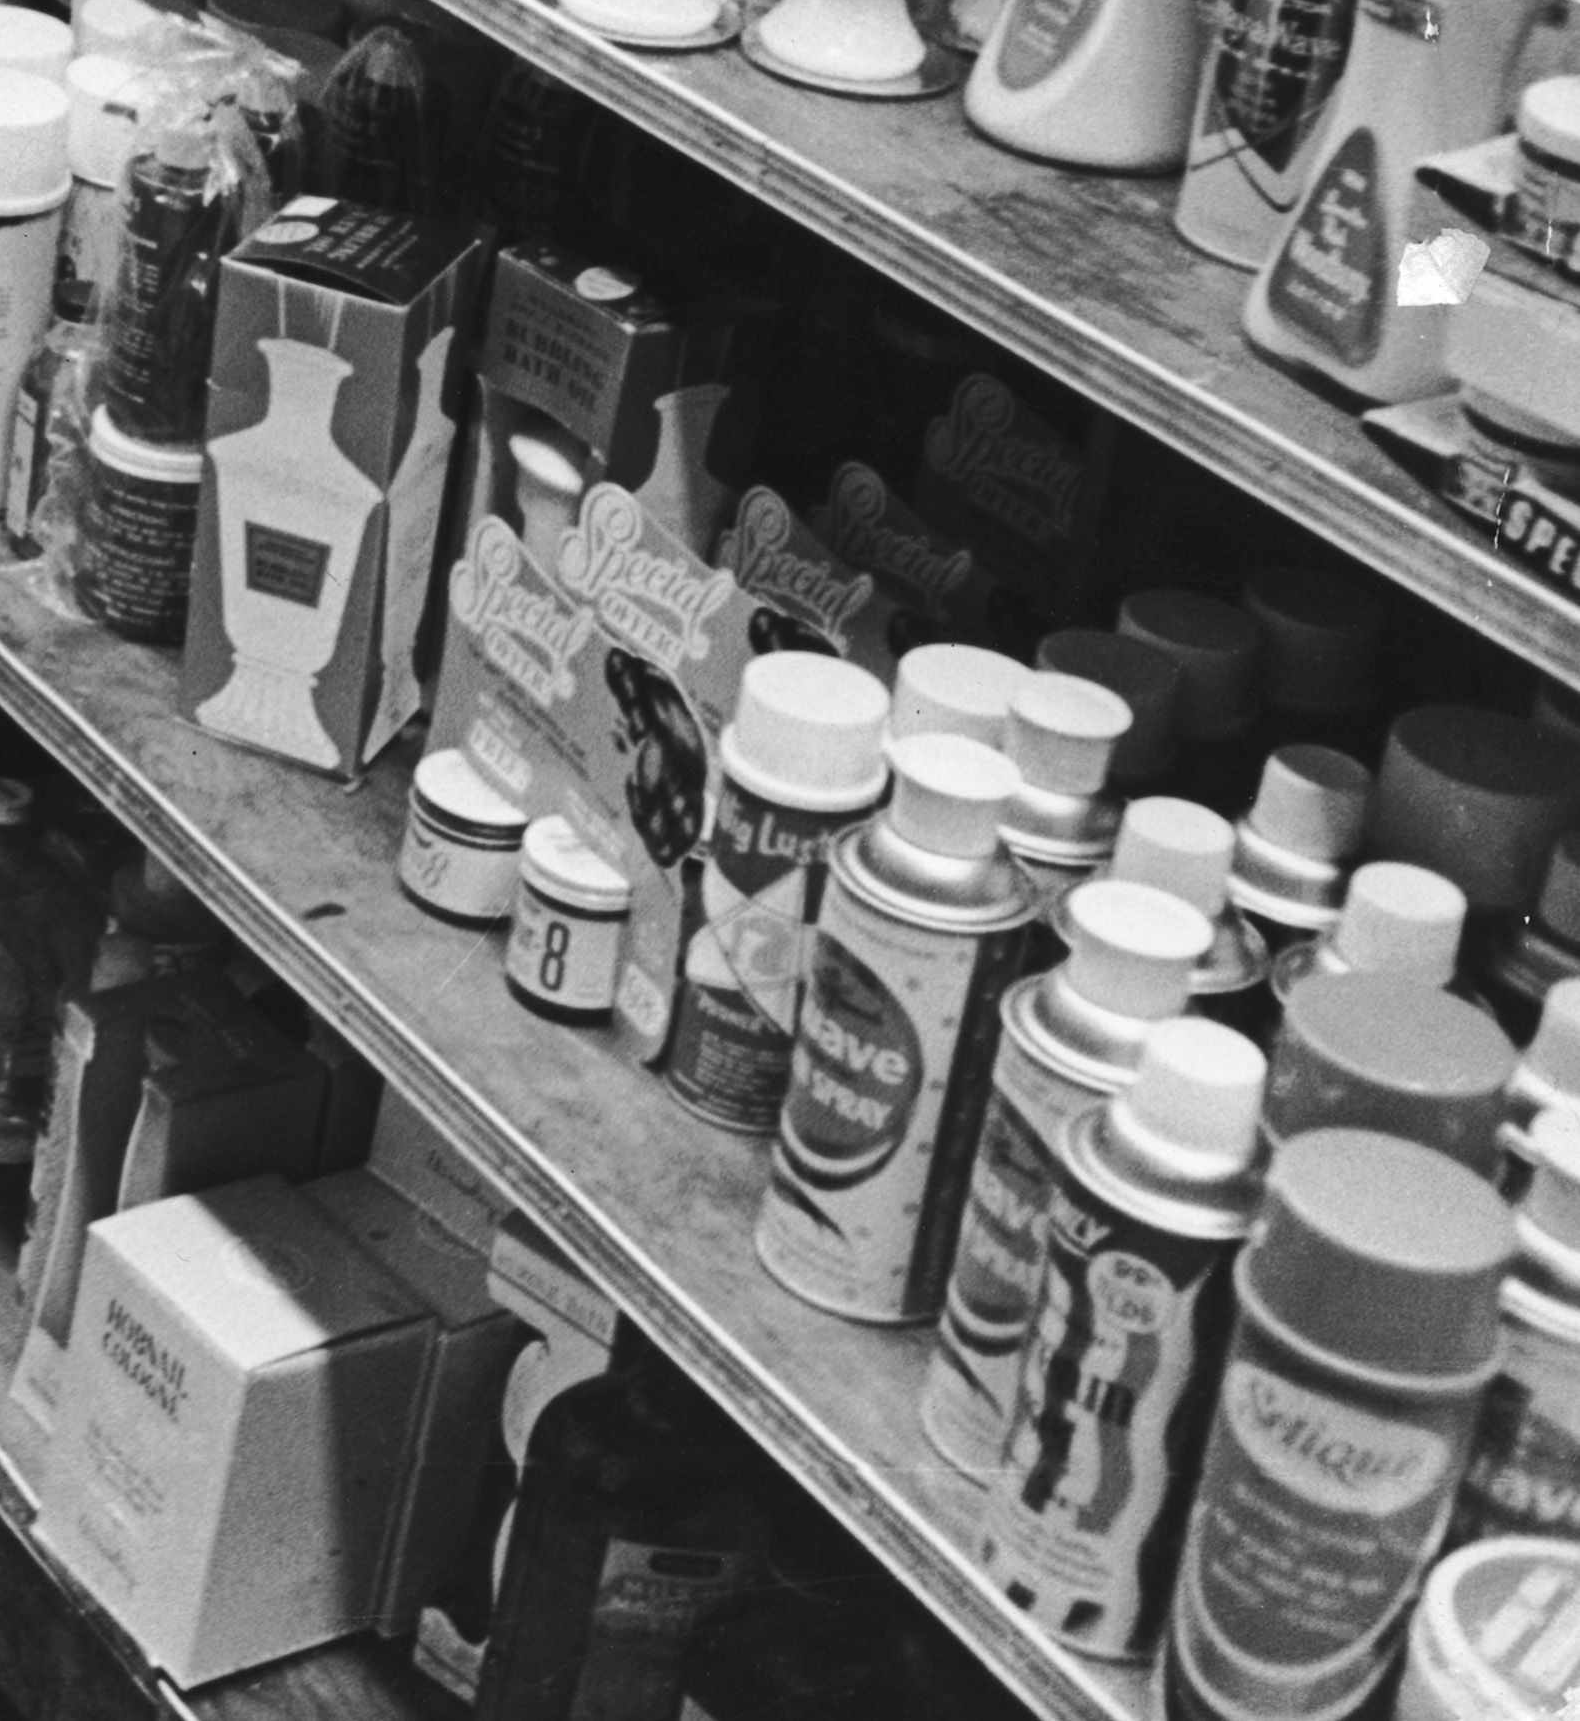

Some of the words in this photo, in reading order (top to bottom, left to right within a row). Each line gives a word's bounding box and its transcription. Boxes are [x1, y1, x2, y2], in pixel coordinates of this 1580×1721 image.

[449, 513, 592, 700] Special
[559, 481, 735, 660] Special
[540, 920, 571, 993] 8
